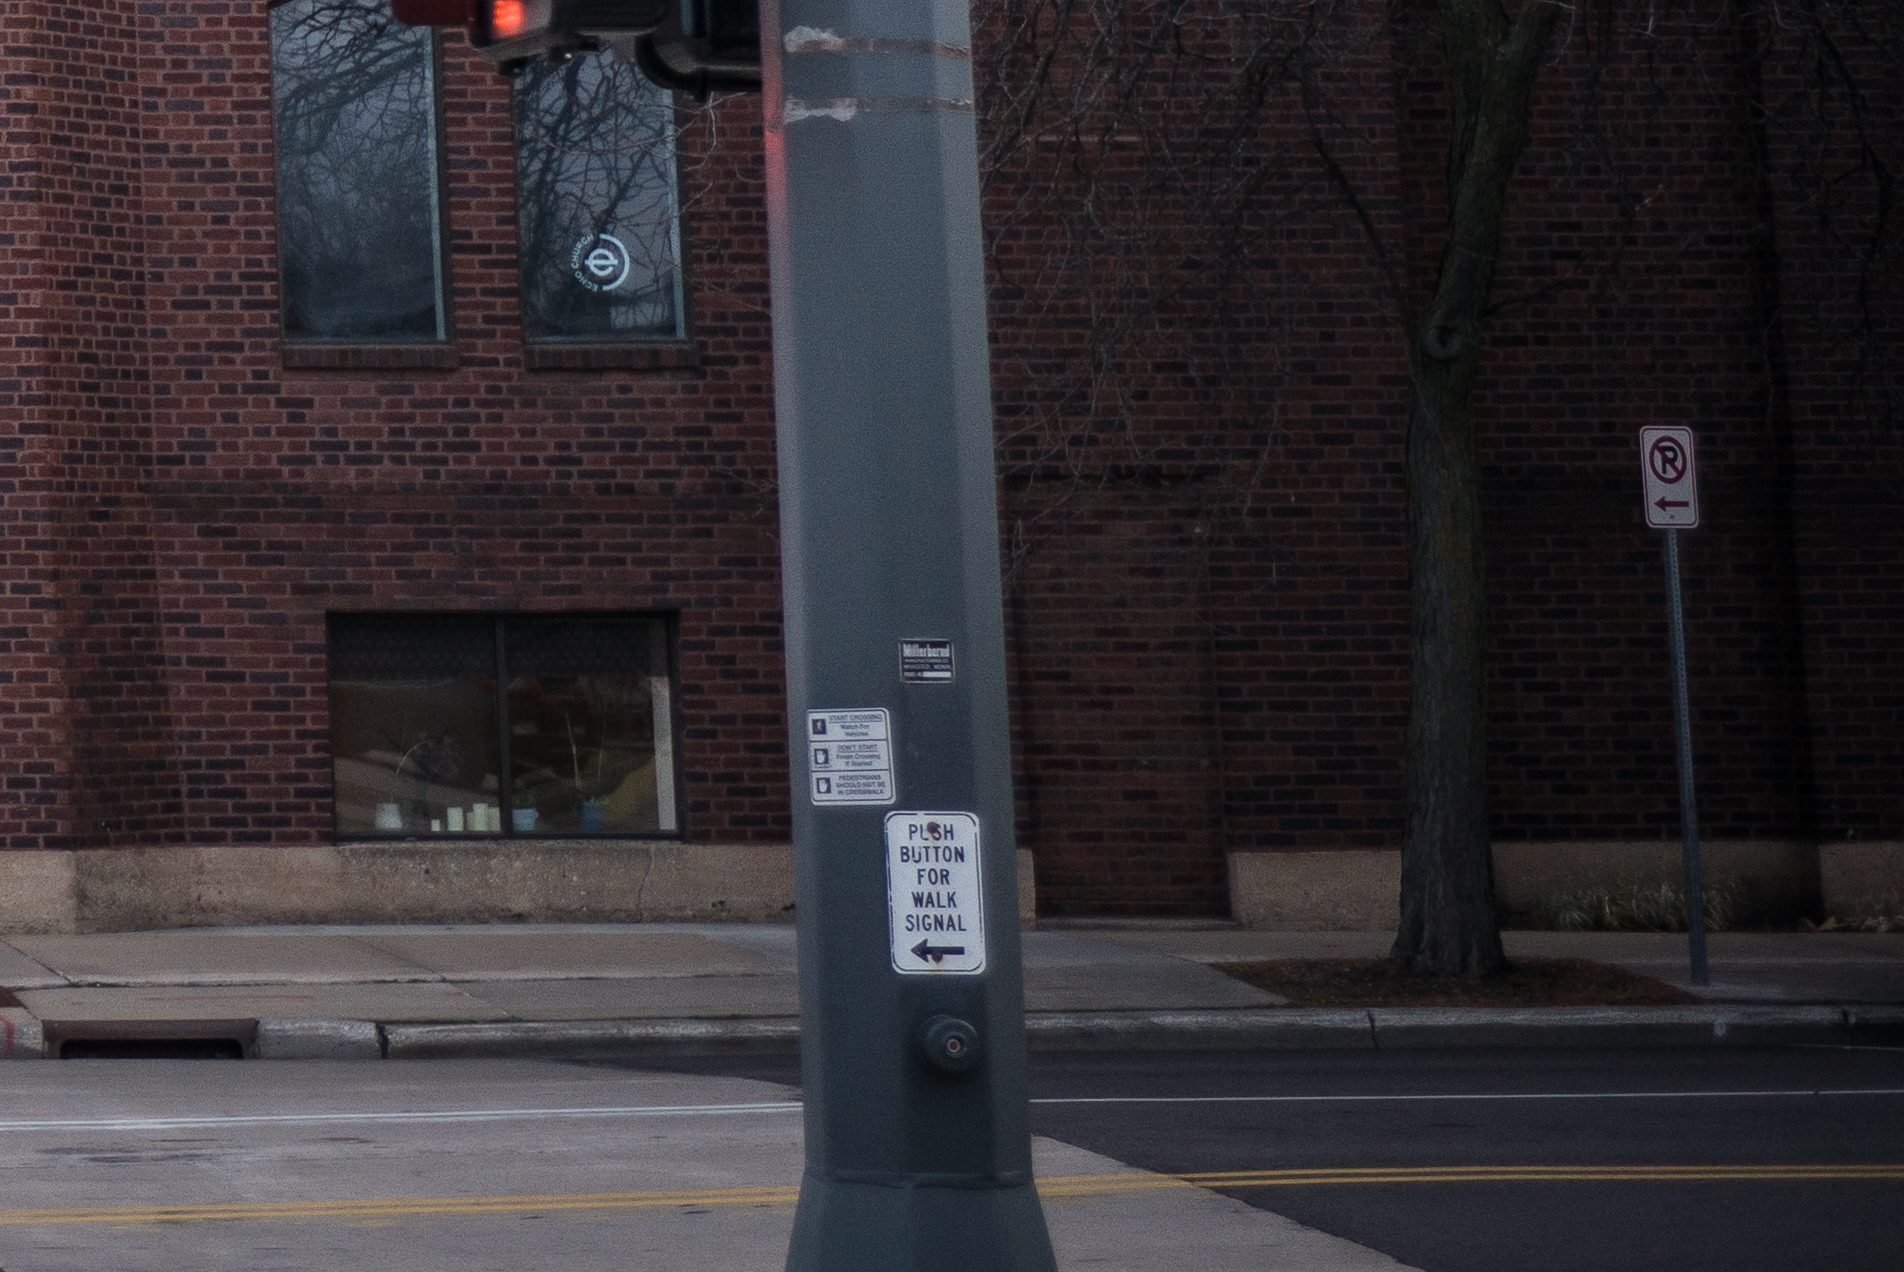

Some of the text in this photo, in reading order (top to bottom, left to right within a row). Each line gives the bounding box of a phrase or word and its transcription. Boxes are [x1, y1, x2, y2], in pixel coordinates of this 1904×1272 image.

[908, 823, 954, 841] PUSH
[900, 846, 965, 863] BUTTON
[917, 868, 950, 885] FOR
[911, 891, 957, 908] WALK
[905, 914, 967, 932] SIGNAL
